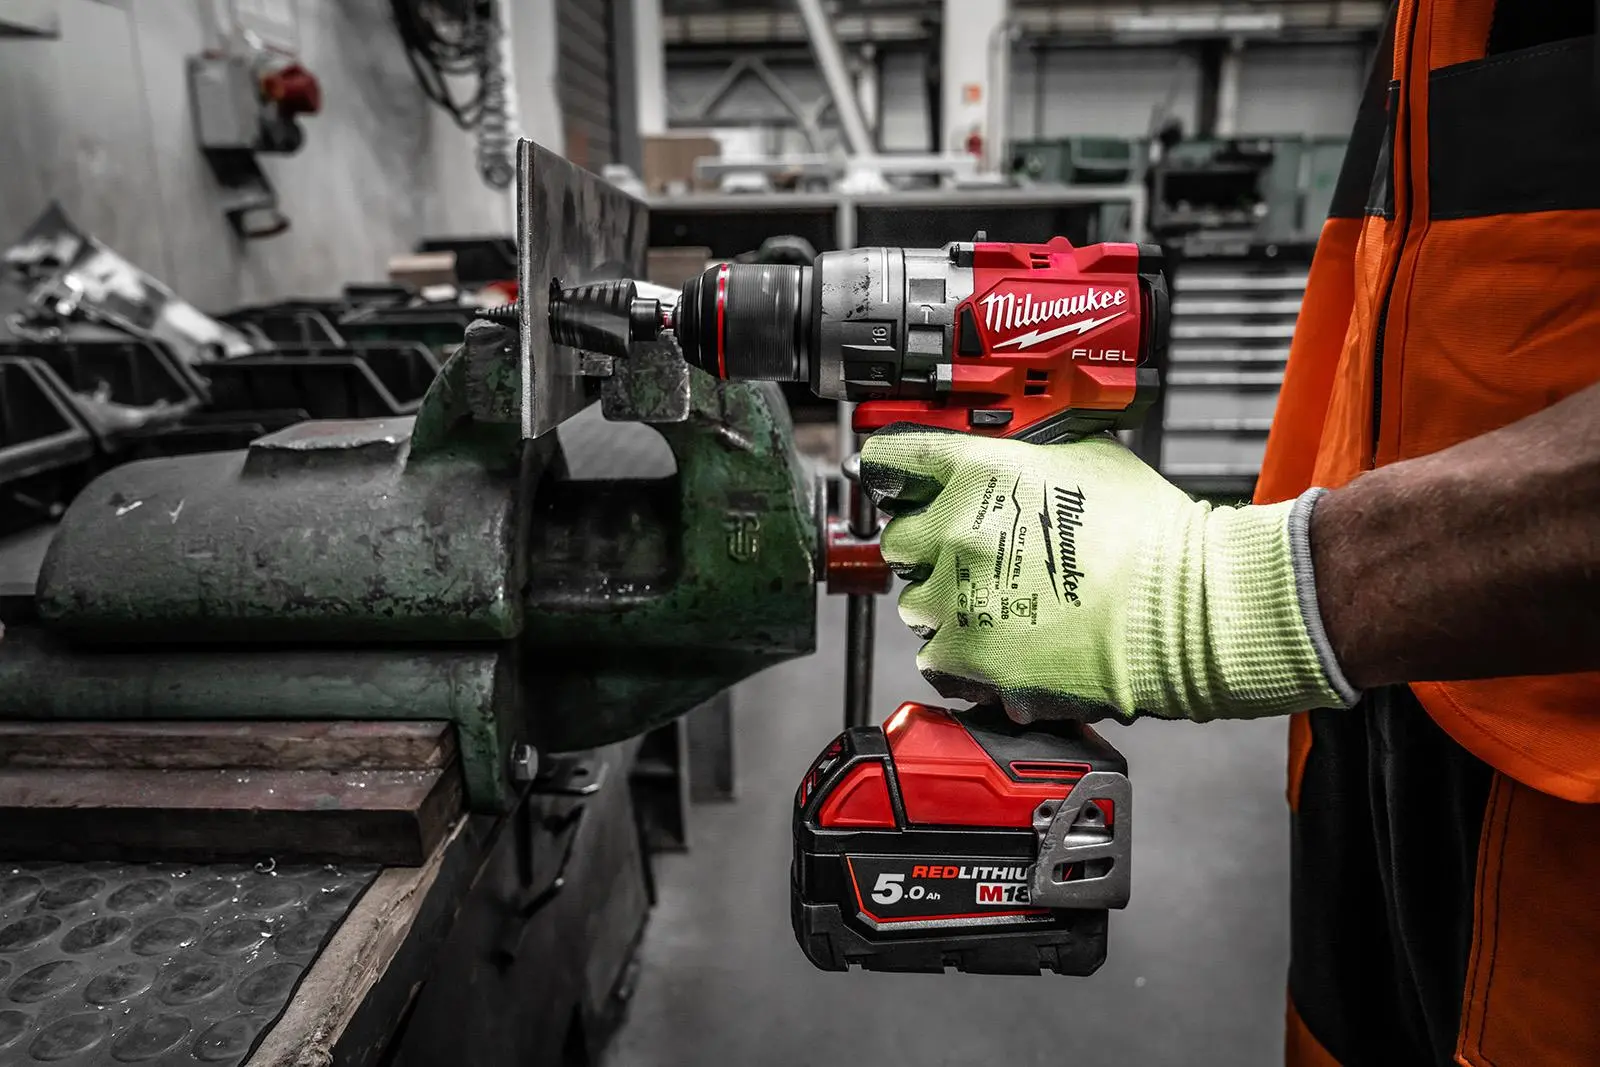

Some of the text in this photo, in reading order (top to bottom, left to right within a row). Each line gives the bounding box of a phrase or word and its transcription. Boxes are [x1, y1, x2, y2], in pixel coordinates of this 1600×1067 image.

[980, 287, 1128, 333] Milwaukee
[872, 326, 887, 344] 16
[1071, 349, 1135, 361] FUEL
[992, 494, 1006, 513] 9/L
[1018, 526, 1028, 546] CUT
[1013, 549, 1023, 580] LEVEL
[911, 864, 1028, 881] REDLITHIU
[871, 873, 941, 904] 5.0 Ah
[979, 885, 1030, 903] M18
